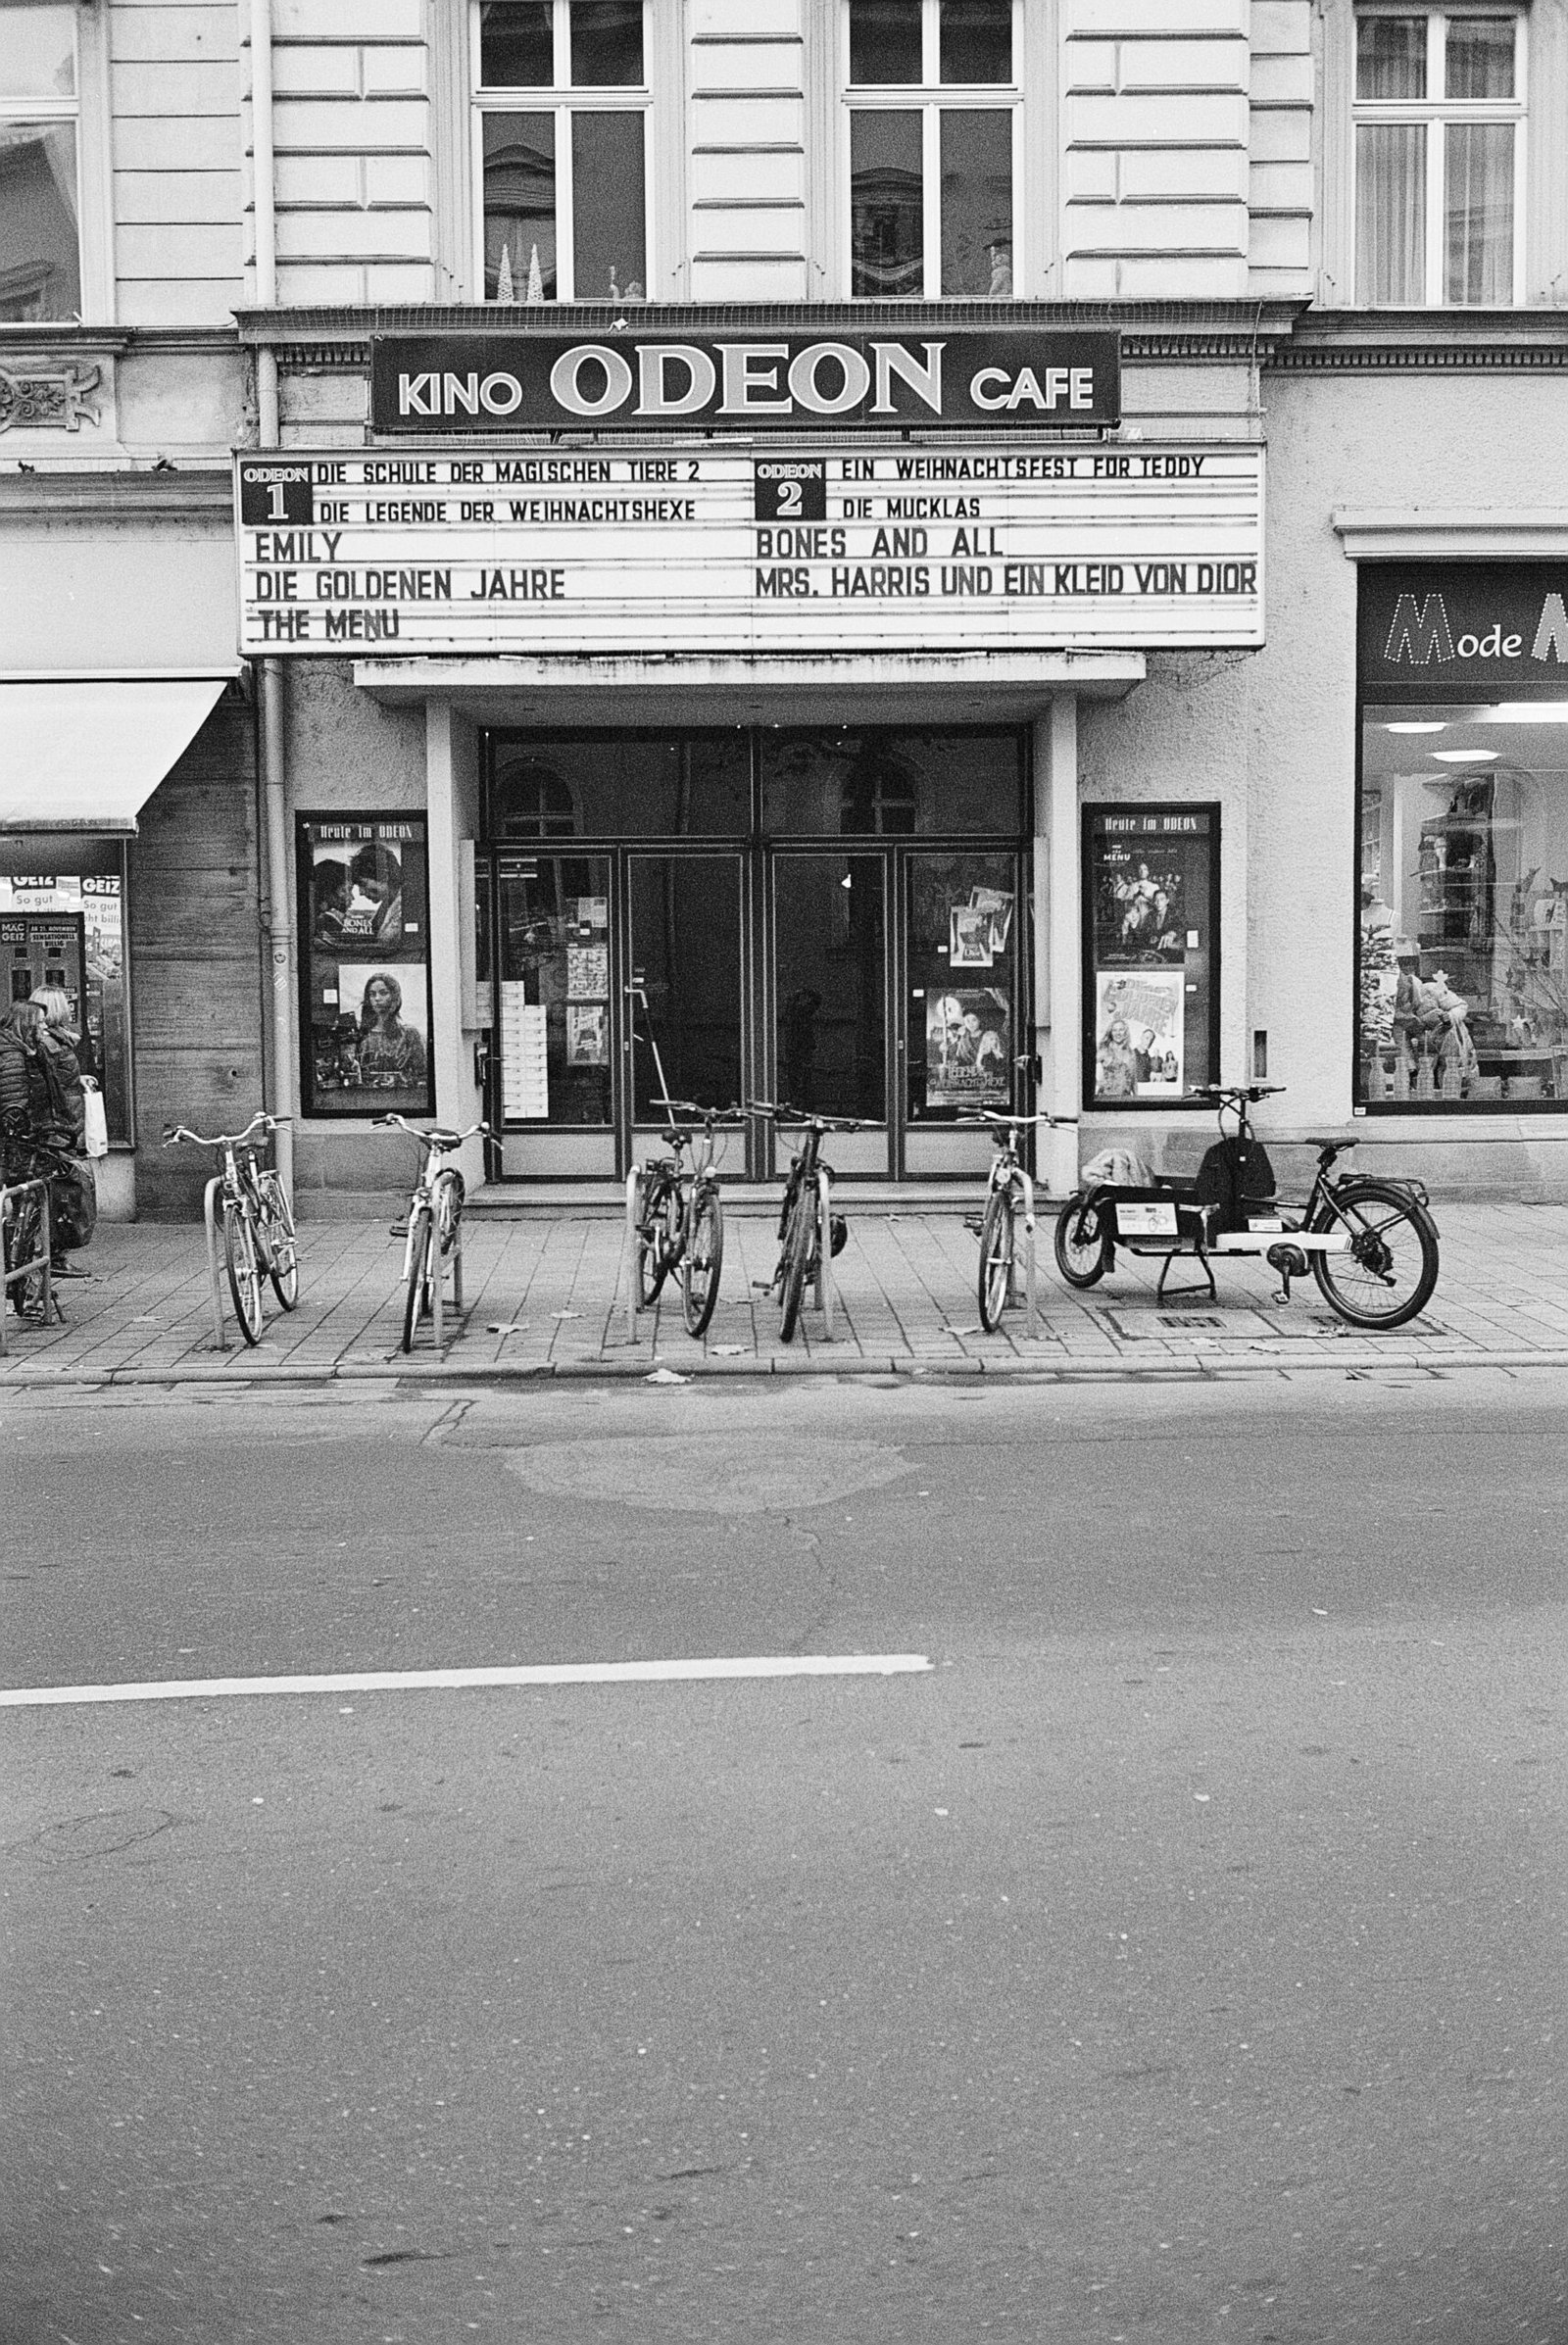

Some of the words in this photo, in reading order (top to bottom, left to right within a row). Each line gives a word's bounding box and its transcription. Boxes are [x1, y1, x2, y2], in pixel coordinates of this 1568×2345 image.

[399, 371, 523, 415] KINO
[550, 342, 948, 416] ODEON
[969, 367, 1094, 410] CAFE
[244, 467, 310, 482] ODEON
[318, 463, 346, 482] DIE
[364, 463, 437, 482] SCHULE
[451, 463, 483, 482] DER
[496, 462, 612, 481] MAGISCHEN
[629, 462, 678, 481] TIERE
[688, 461, 701, 480] 2
[757, 464, 823, 479] ODEON
[843, 459, 874, 478] EIN
[896, 458, 1078, 478] WEIHNACHTSFEST
[1140, 456, 1205, 476] TEDDY
[267, 482, 289, 519] 1
[776, 481, 803, 515] 2
[844, 499, 873, 518] DIE
[887, 498, 980, 517] MUCKLAS
[320, 502, 349, 522] DIE
[366, 501, 447, 521] LEGENDE
[461, 501, 494, 521] DER
[510, 500, 696, 520] WEIHNACHTSHEXE
[256, 532, 342, 562] EMILY
[756, 528, 847, 559] BONES
[872, 528, 928, 558] AND
[952, 527, 1004, 557] ALL
[257, 570, 298, 601] DIE
[317, 569, 452, 600] GOLDENEN
[470, 568, 565, 599] JAHRE
[756, 567, 818, 597] MRS.
[832, 566, 929, 596] HARRIS
[941, 565, 993, 596] UND
[1004, 564, 1045, 595] EIN
[1054, 564, 1124, 595] KLEID
[1134, 564, 1190, 594] VON
[1198, 563, 1258, 594] DIOR
[259, 610, 310, 640] THE
[325, 609, 400, 639] MENU
[320, 825, 352, 839] Heute
[359, 825, 372, 839] im
[378, 824, 413, 839] ODEON
[1105, 817, 1136, 831] Heute
[1143, 817, 1156, 831] im
[1163, 816, 1197, 831] ODEON
[82, 878, 120, 894] GEIZ
[17, 895, 30, 904] So
[34, 895, 53, 906] gut
[84, 900, 96, 909] So
[100, 902, 118, 912] gut
[2, 933, 24, 942] GEIZ
